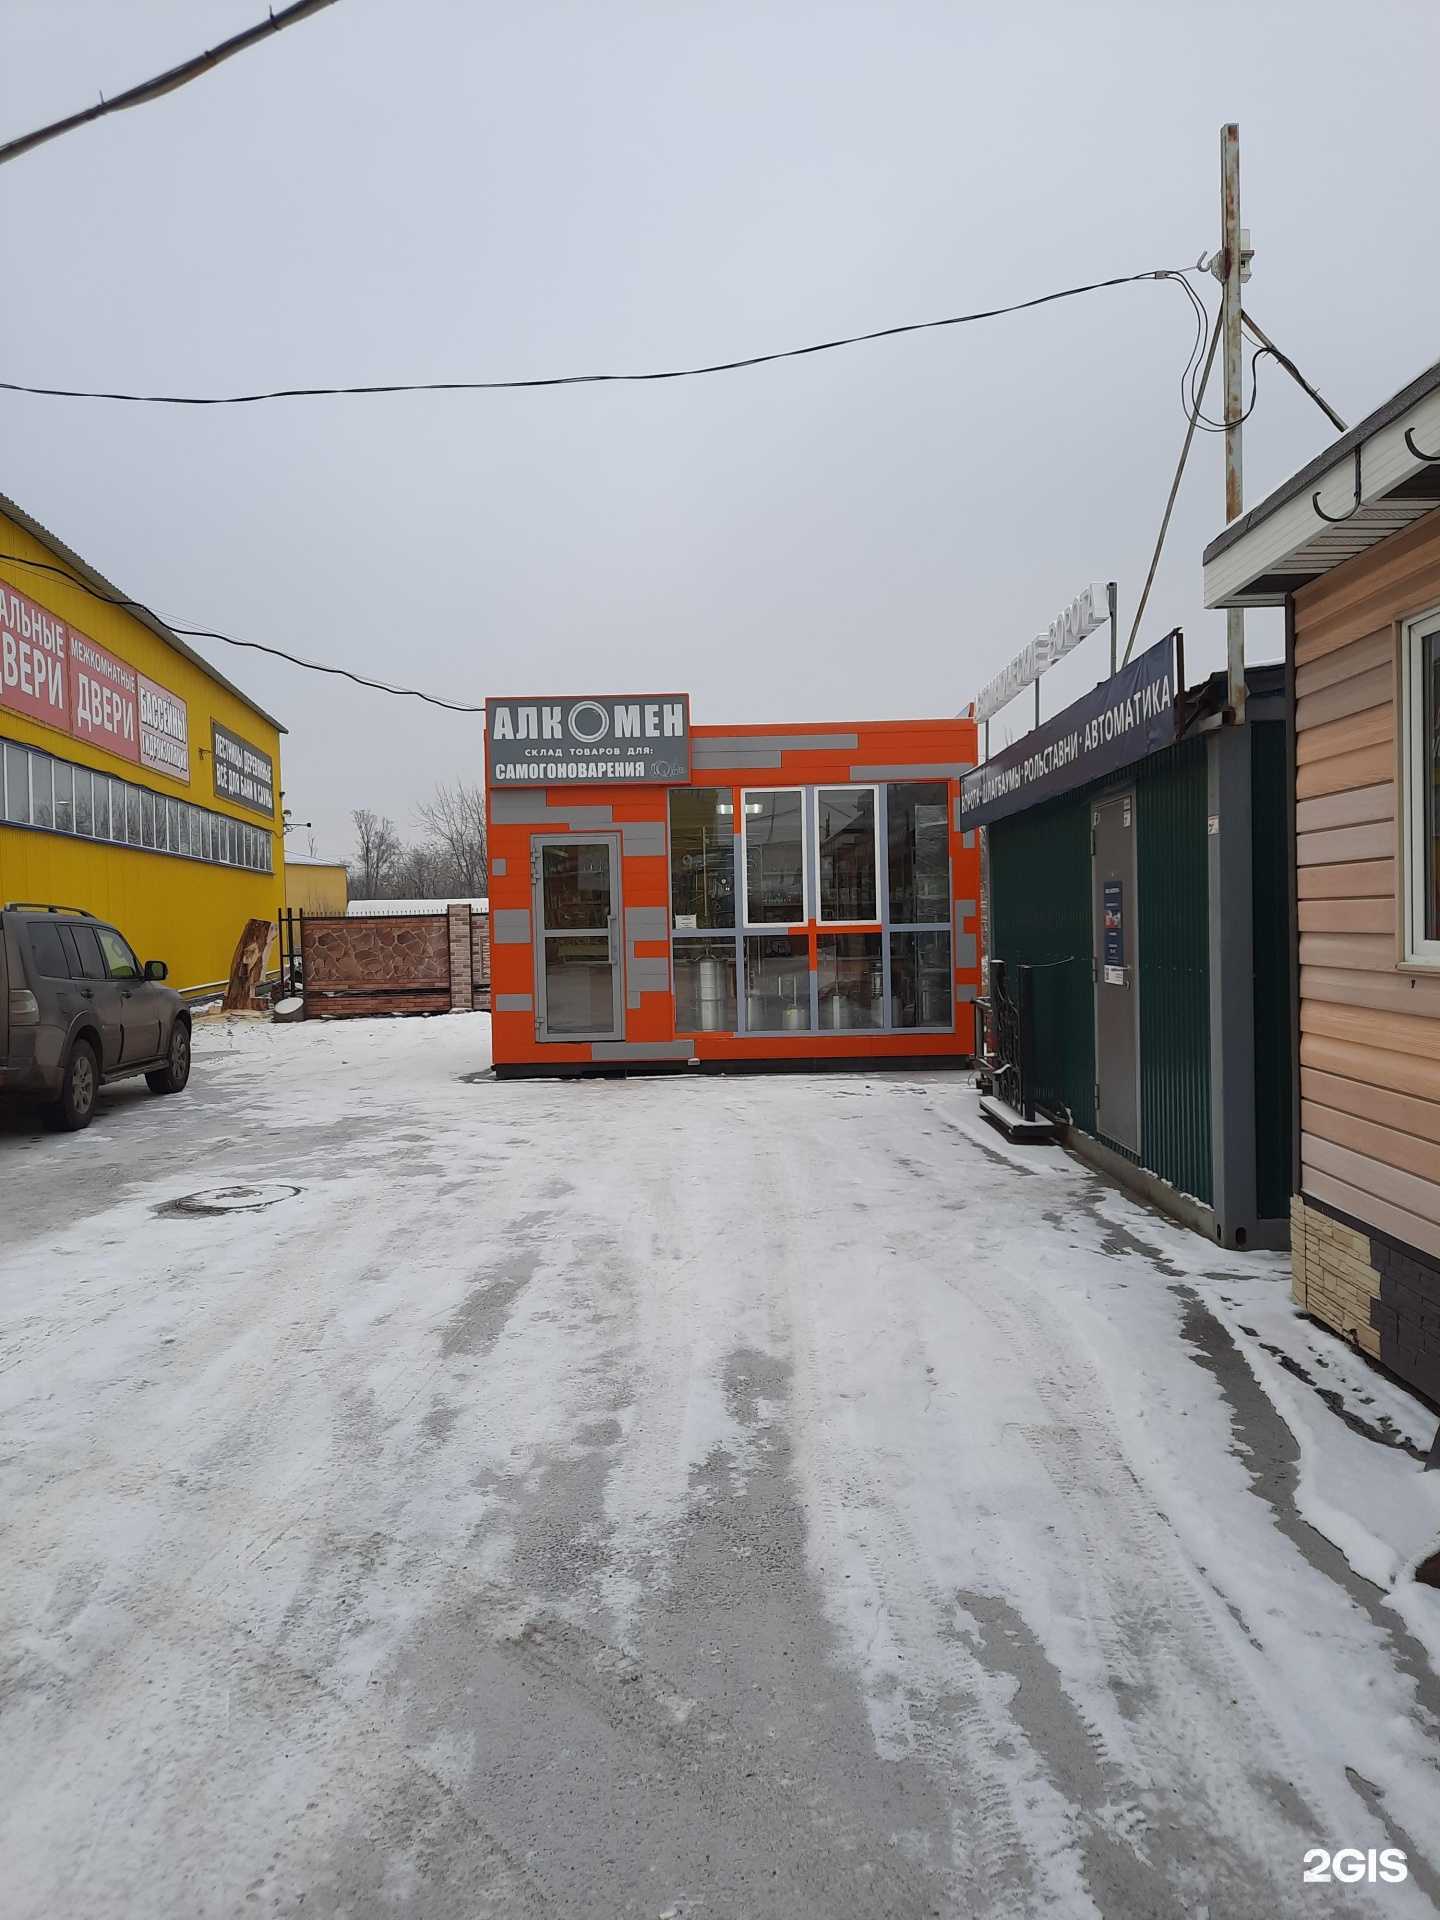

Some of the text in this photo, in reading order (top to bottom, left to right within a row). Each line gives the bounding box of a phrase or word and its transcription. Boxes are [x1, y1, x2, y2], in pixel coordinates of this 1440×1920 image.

[0, 631, 63, 709] ВЕРИ
[70, 637, 136, 693] МЕЖКОМНАТНЫЕ
[77, 672, 134, 742] ДВЕРИ
[140, 687, 186, 744] БАССЕЙНЫ
[493, 700, 684, 743] АЛКОМЕН
[215, 733, 243, 771] ЛЕСТНИЦЫ
[524, 746, 654, 757] СКЛАД ТОВАРОВ ДЛЯ:
[961, 786, 981, 815] ВОРОТА
[982, 764, 1022, 804] ШЛАГБАУМЫ
[1024, 730, 1079, 785] РОЛЬСТАВНИ
[1084, 675, 1171, 753] АВТОМАТИКА
[216, 763, 227, 788] ВСЁ
[228, 769, 240, 795] ДЛЯ
[240, 775, 253, 801] БАНИ
[495, 761, 645, 780] САМОГОНОВАРЕНИЯ
